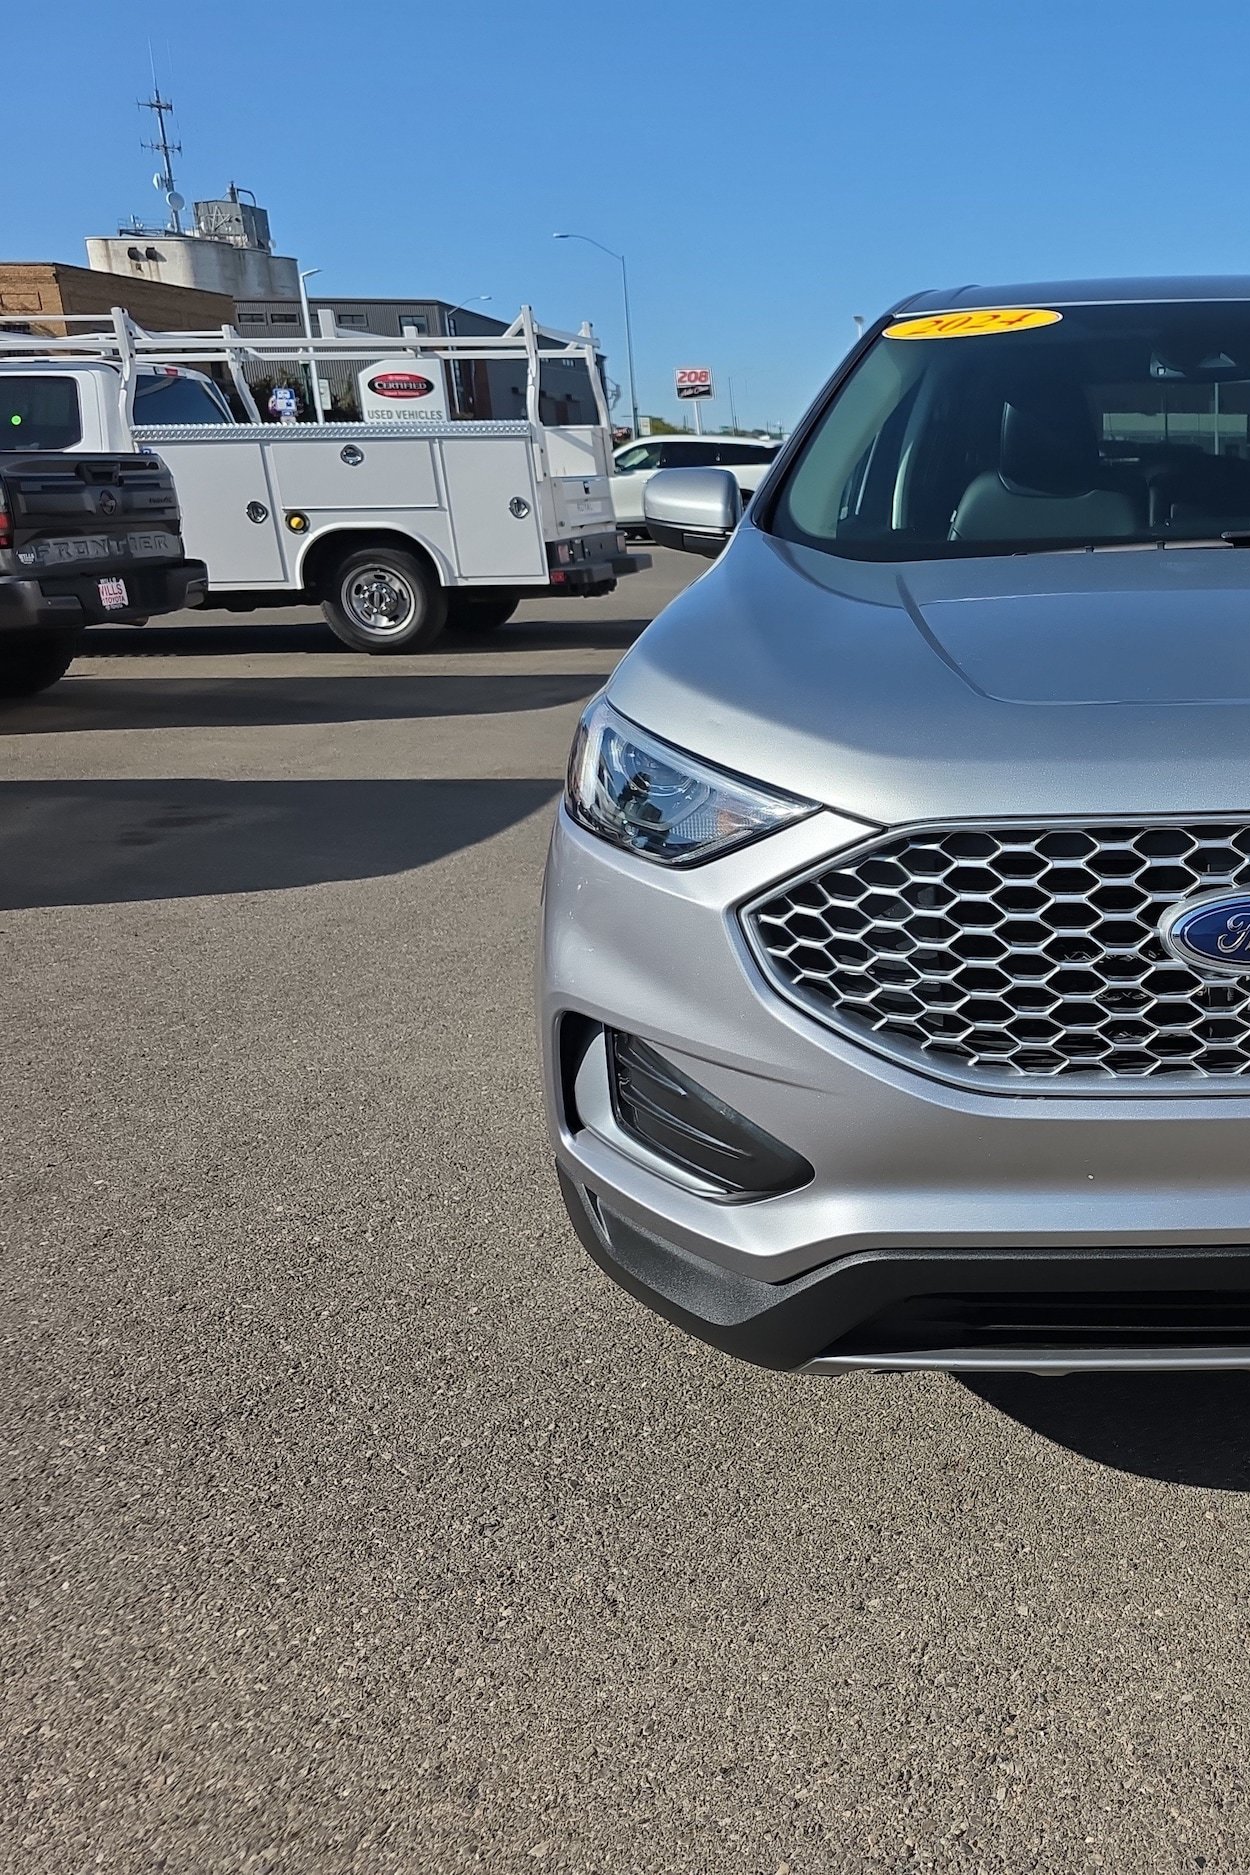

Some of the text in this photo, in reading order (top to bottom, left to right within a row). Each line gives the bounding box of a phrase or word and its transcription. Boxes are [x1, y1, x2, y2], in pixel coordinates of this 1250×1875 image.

[906, 311, 1037, 336] 2024
[678, 371, 709, 383] 208
[374, 381, 427, 390] CERTIFIED
[368, 410, 443, 420] USED VEHICLES
[35, 535, 169, 563] FRONTIER
